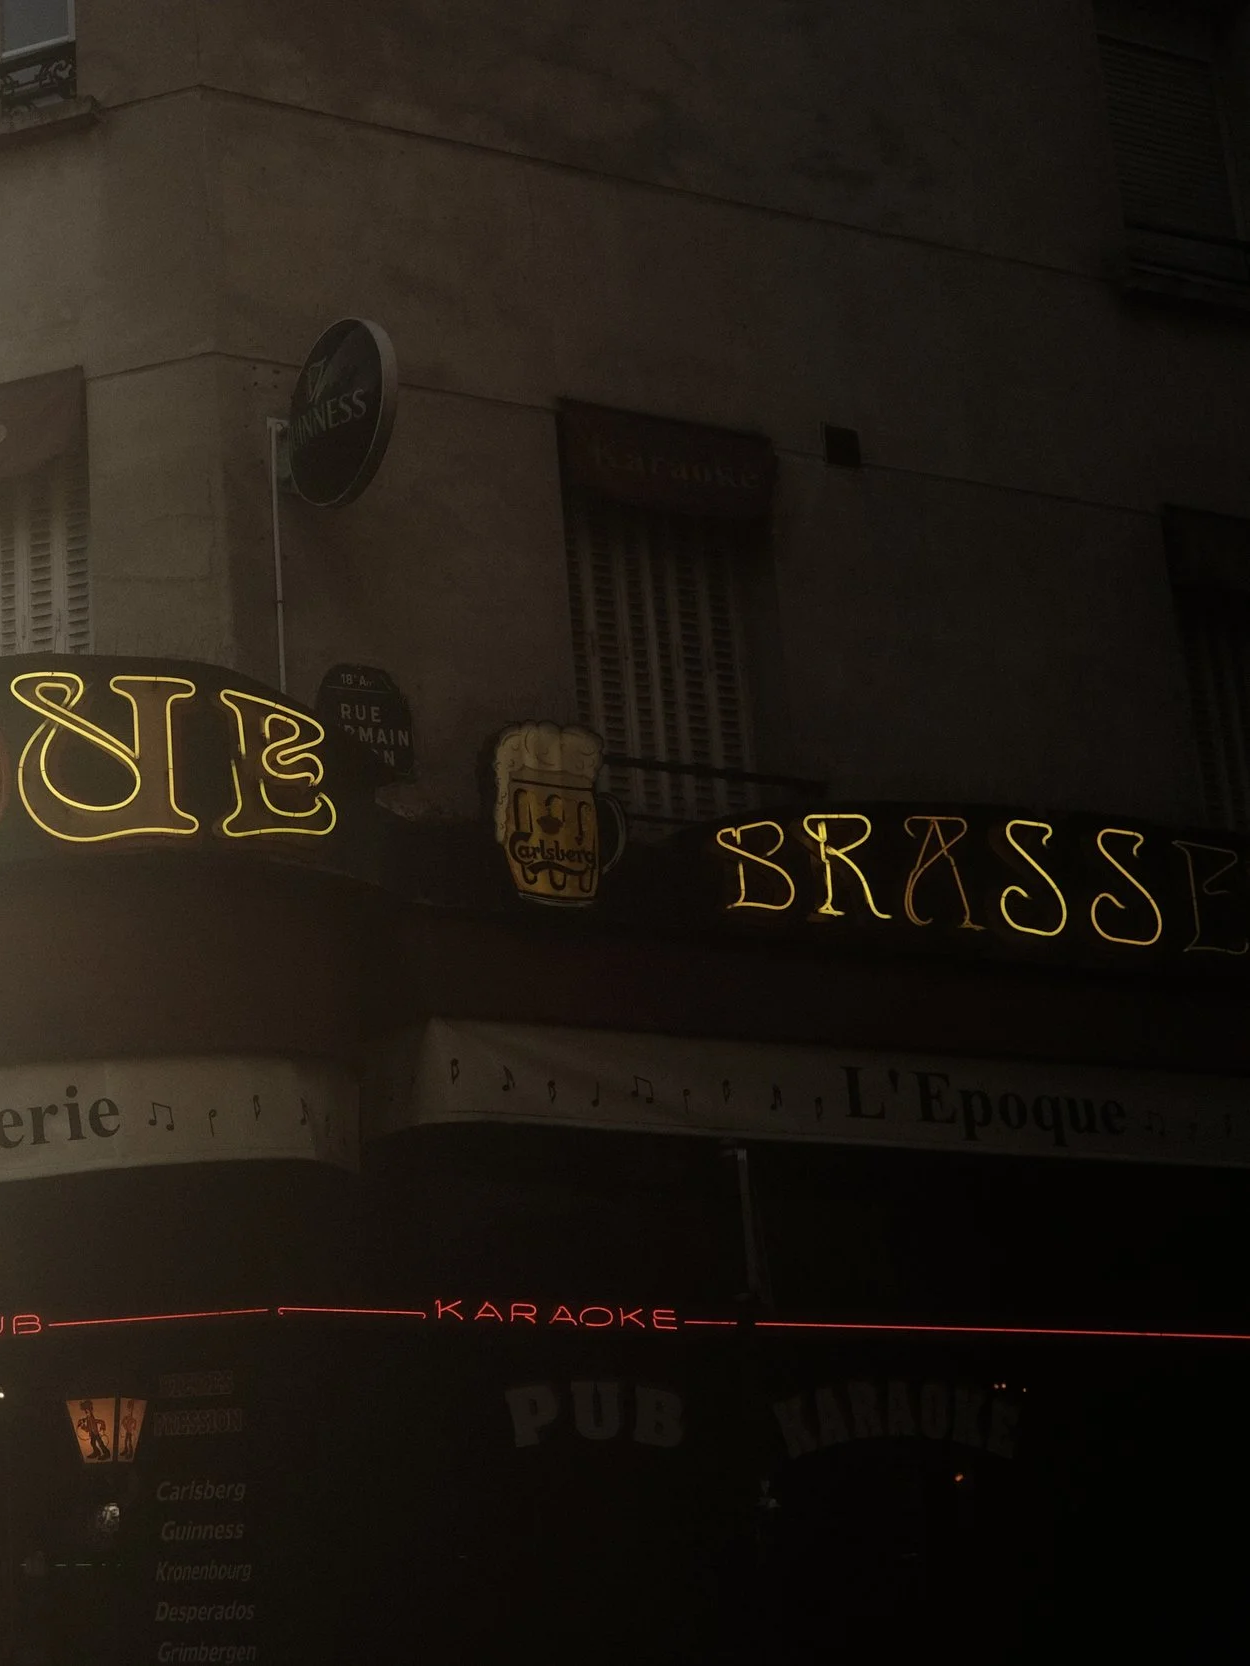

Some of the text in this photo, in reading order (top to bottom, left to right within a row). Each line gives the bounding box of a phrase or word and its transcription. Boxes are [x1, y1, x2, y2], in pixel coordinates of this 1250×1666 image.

[339, 702, 382, 723] RUE
[508, 830, 598, 872] Carlsberg
[715, 813, 1250, 956] BRASSE
[840, 1064, 1128, 1147] L'Epoque
[434, 1296, 679, 1332] KARAOKE
[504, 1378, 688, 1449] PUB
[771, 1375, 1023, 1460] KARAOKE
[156, 1480, 247, 1502] Carlsberg
[160, 1519, 245, 1543] Guinness
[155, 1560, 253, 1584] Kronenbourg
[154, 1601, 256, 1625] Desperados
[157, 1640, 257, 1666] Grimbergen
